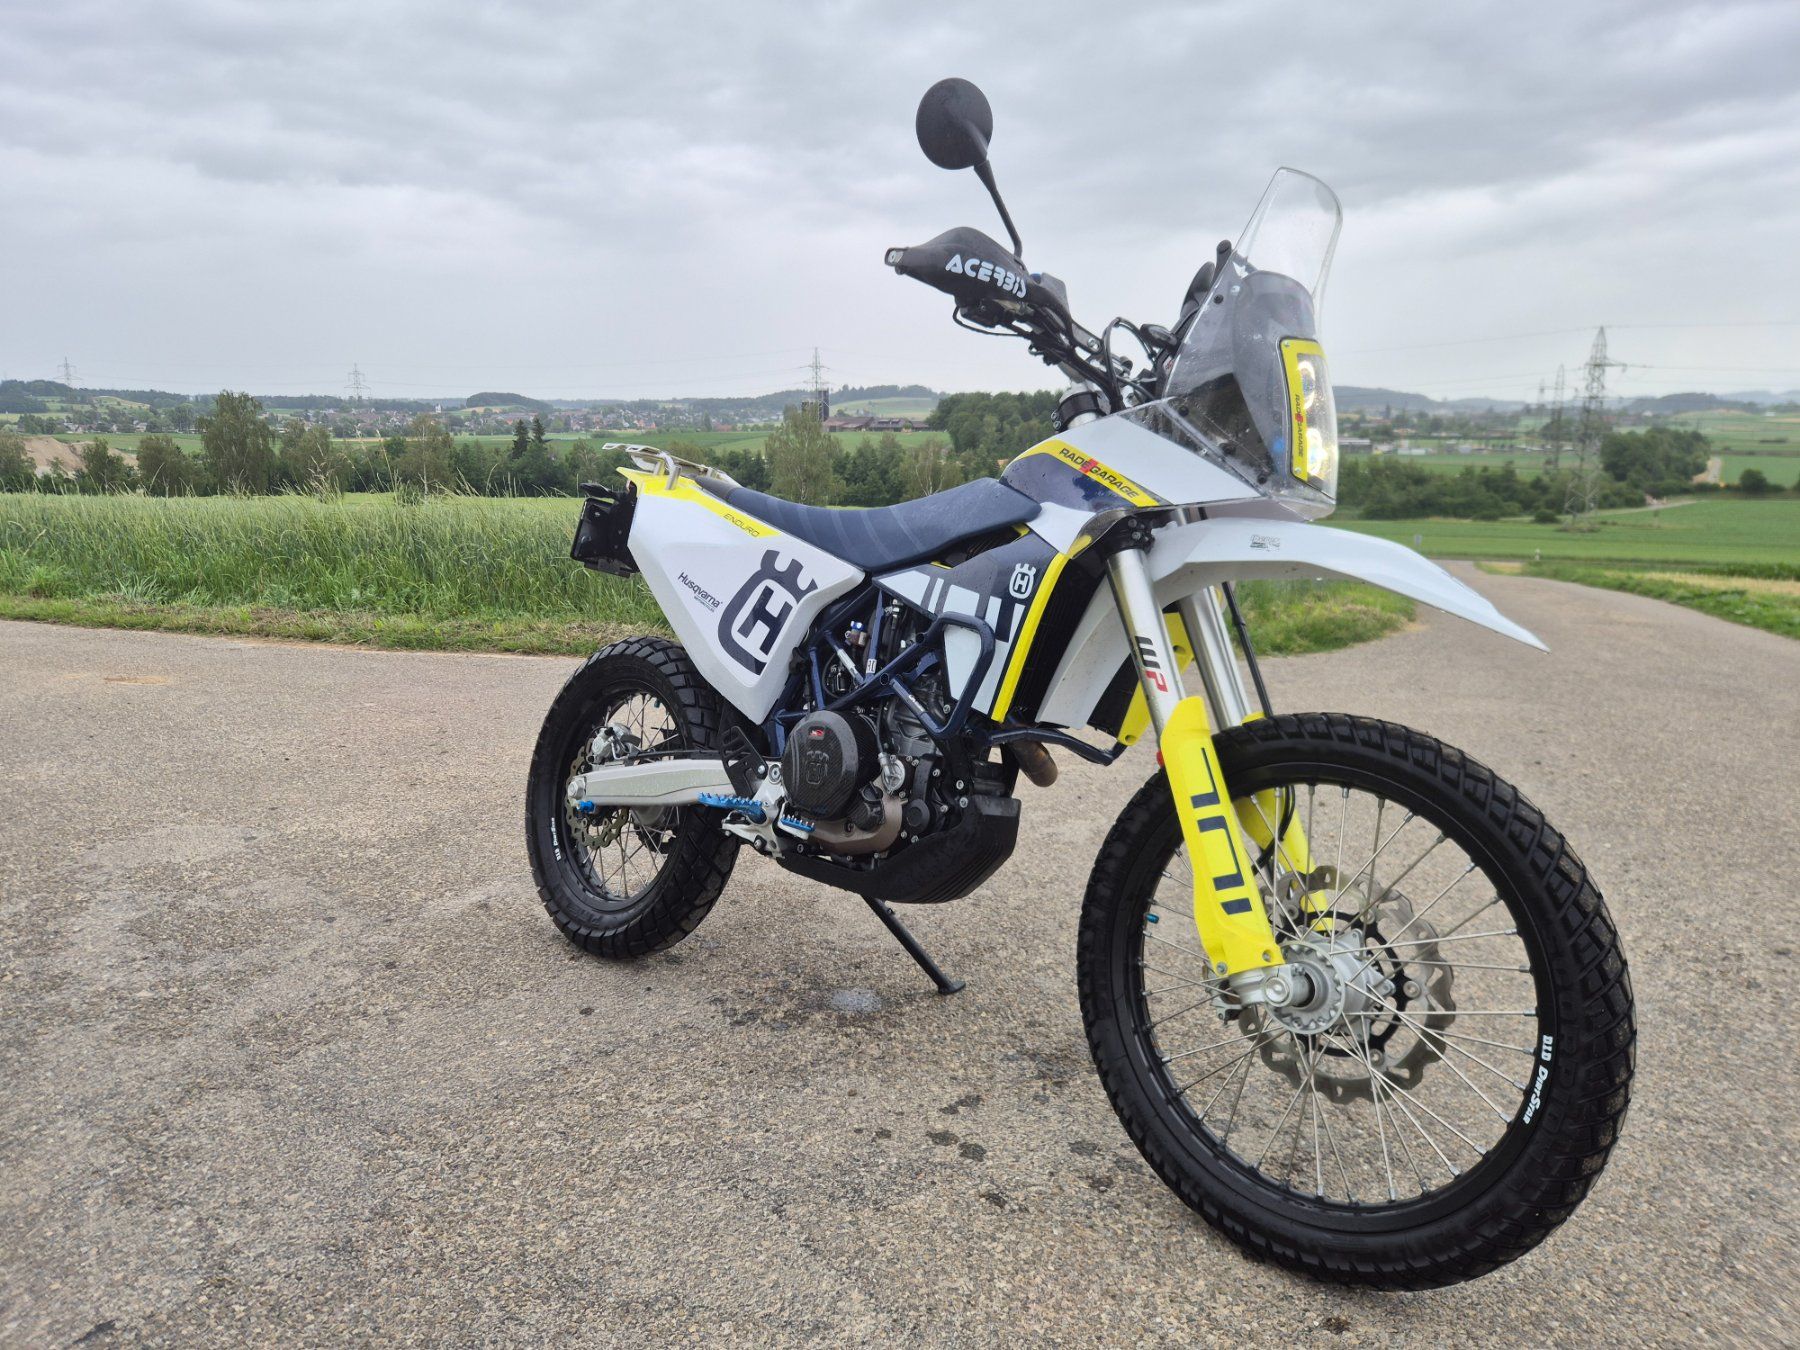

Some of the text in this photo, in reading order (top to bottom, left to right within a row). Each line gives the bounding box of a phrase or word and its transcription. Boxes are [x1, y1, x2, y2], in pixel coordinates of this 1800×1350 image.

[945, 254, 1027, 299] ACERBIS
[1060, 448, 1139, 499] RADE GARAGE
[722, 513, 760, 538] ENDURO
[677, 571, 721, 609] Husqvarna
[1541, 1035, 1553, 1061] DID
